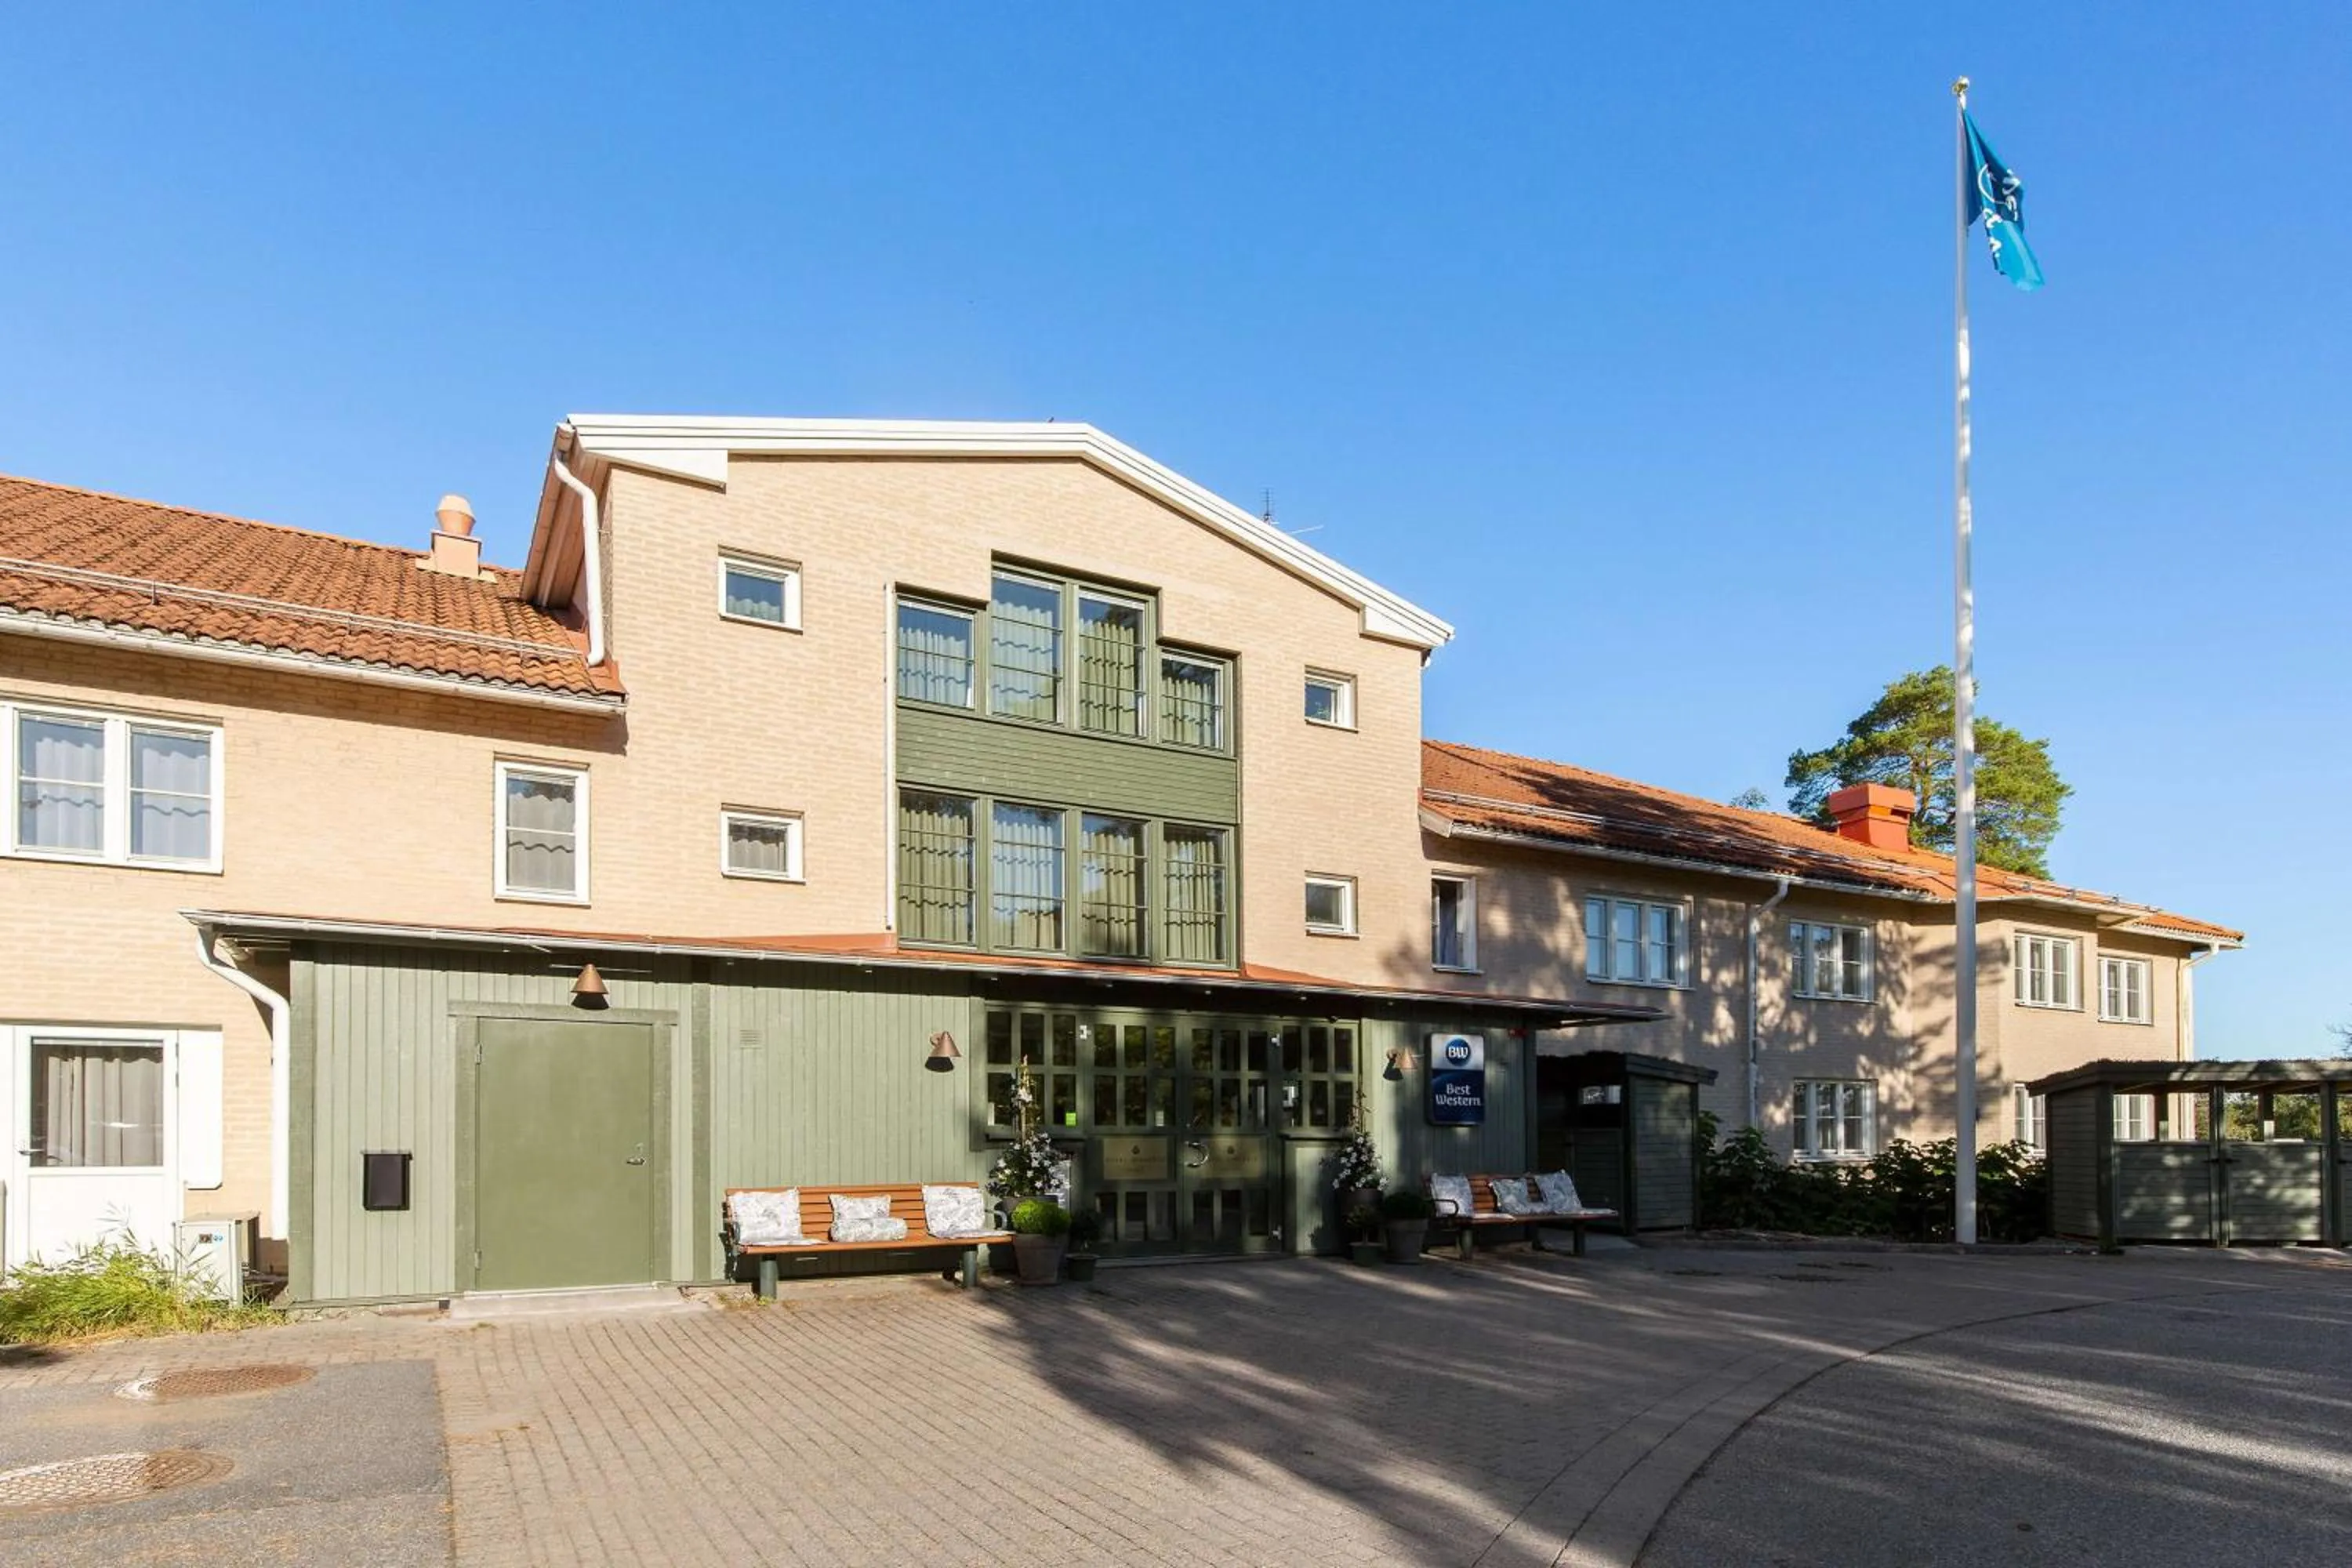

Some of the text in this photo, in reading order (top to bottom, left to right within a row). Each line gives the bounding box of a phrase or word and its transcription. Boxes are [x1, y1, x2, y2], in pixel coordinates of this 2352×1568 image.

[1448, 1047, 1468, 1058] BW
[1446, 1083, 1471, 1094] Best
[1436, 1094, 1481, 1106] Western
